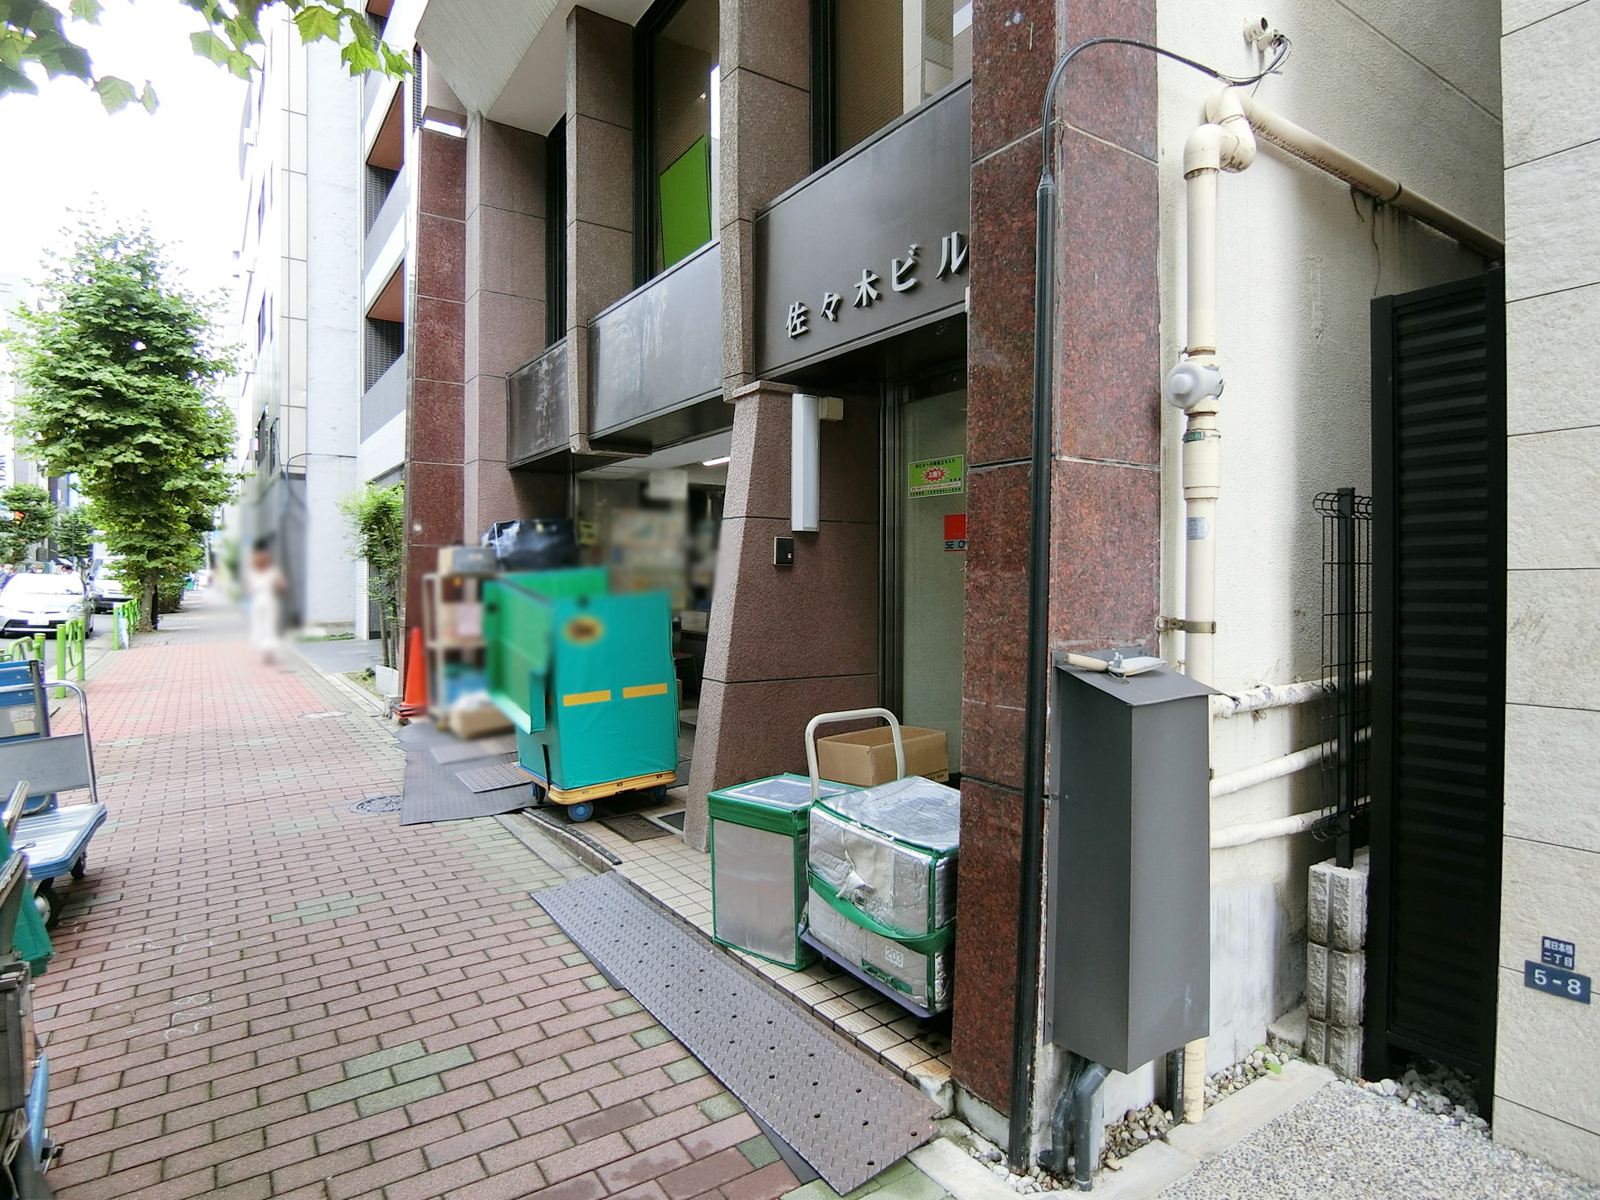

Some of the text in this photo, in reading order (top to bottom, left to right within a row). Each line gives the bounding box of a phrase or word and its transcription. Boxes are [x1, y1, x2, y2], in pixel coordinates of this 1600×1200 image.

[785, 231, 969, 339] 佐々木ビル
[886, 947, 902, 965] 203
[1543, 938, 1574, 956] 東日本橋
[1543, 951, 1573, 968] 二丁目
[1534, 969, 1581, 995] 5-8
